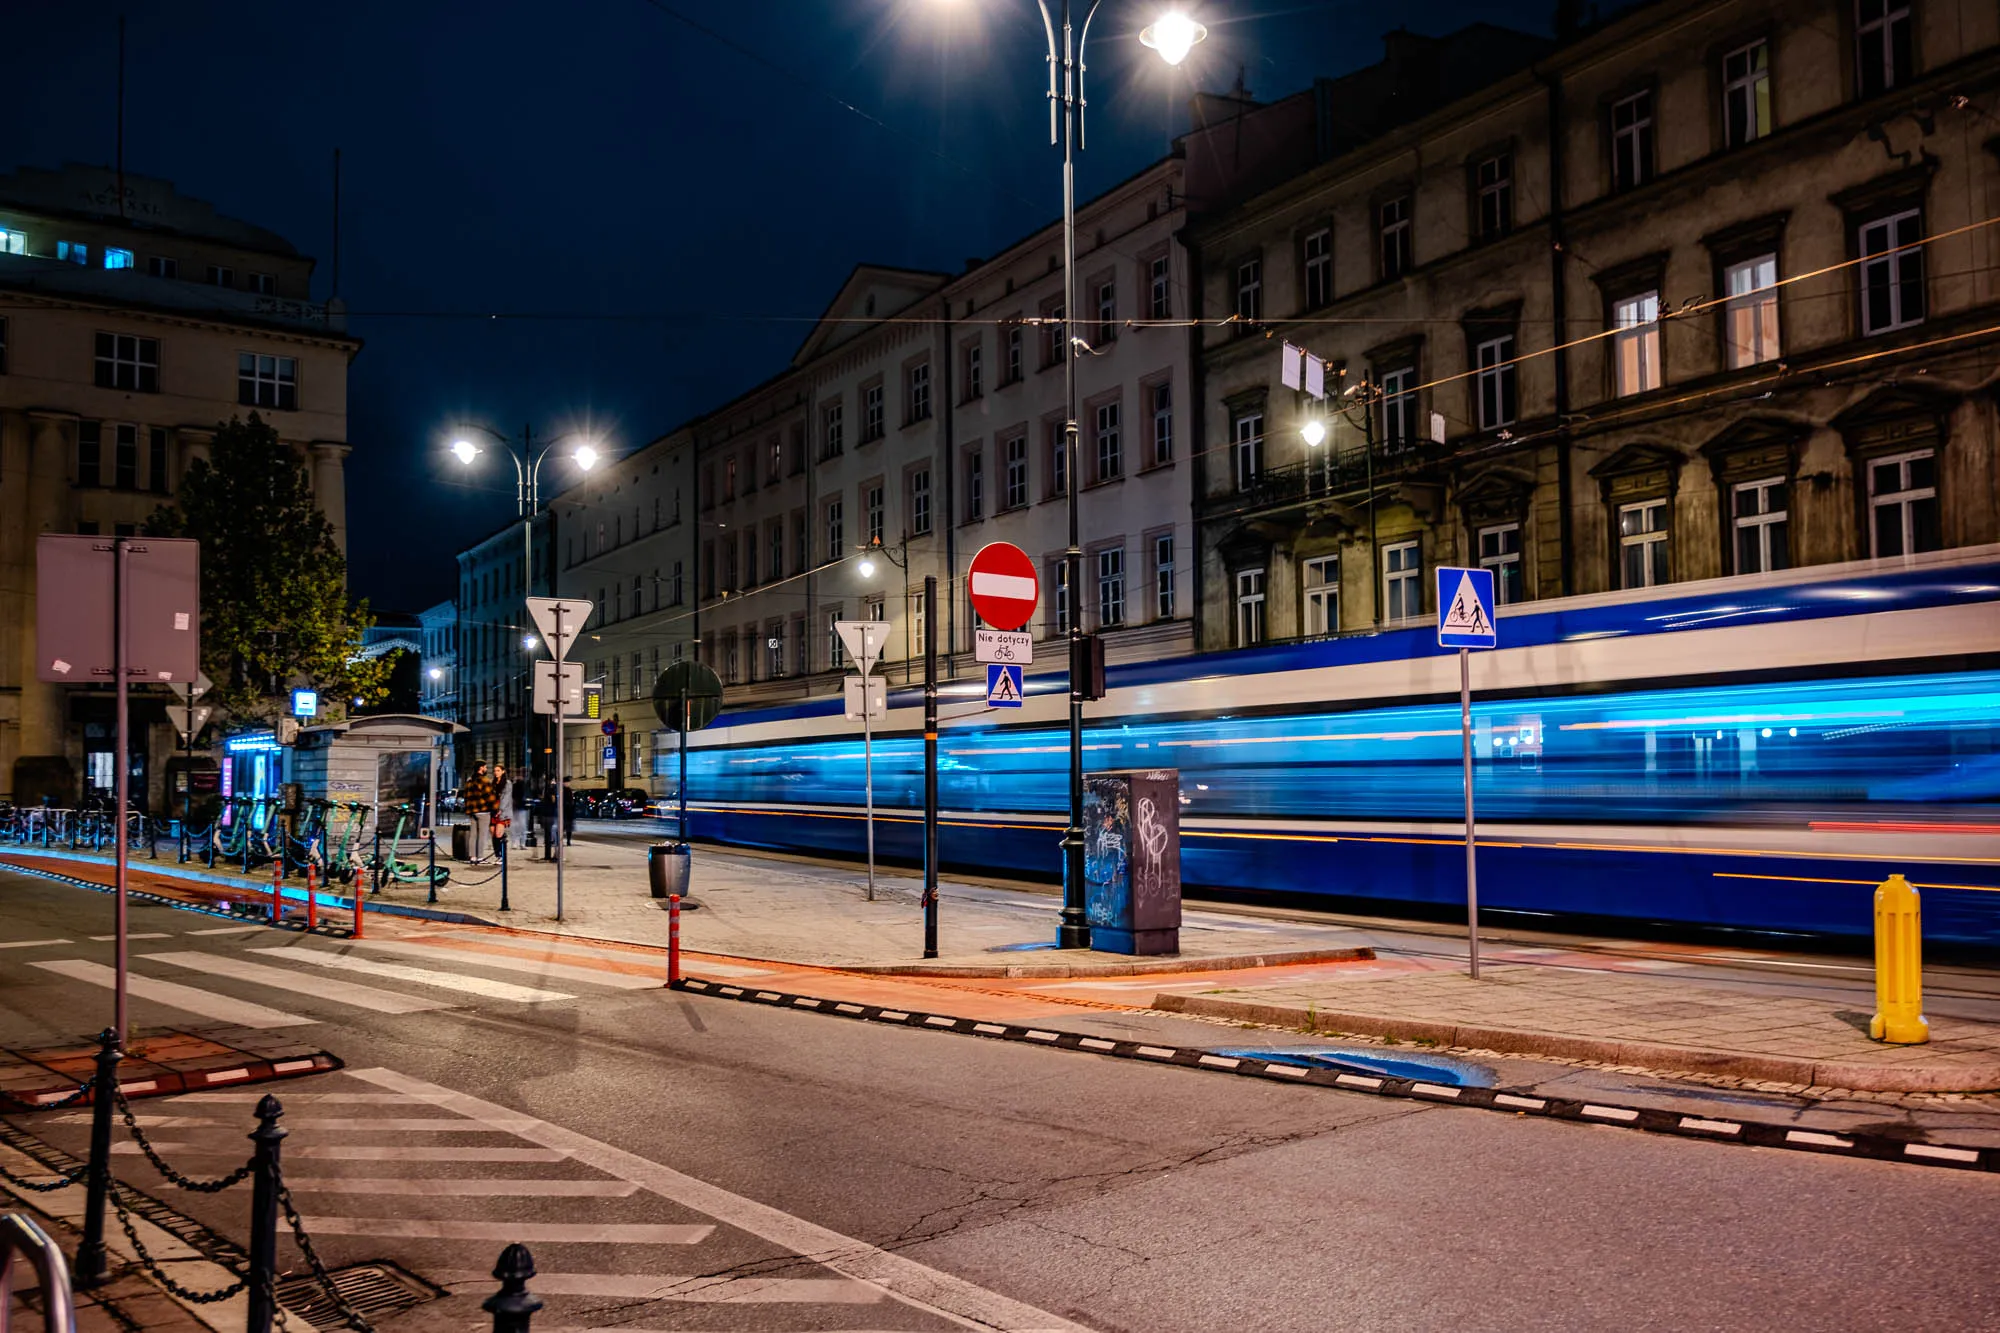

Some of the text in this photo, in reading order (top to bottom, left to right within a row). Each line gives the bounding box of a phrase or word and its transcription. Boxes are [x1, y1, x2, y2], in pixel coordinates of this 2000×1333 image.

[978, 633, 1029, 646] Nie dotyczy
[605, 748, 614, 757] P
